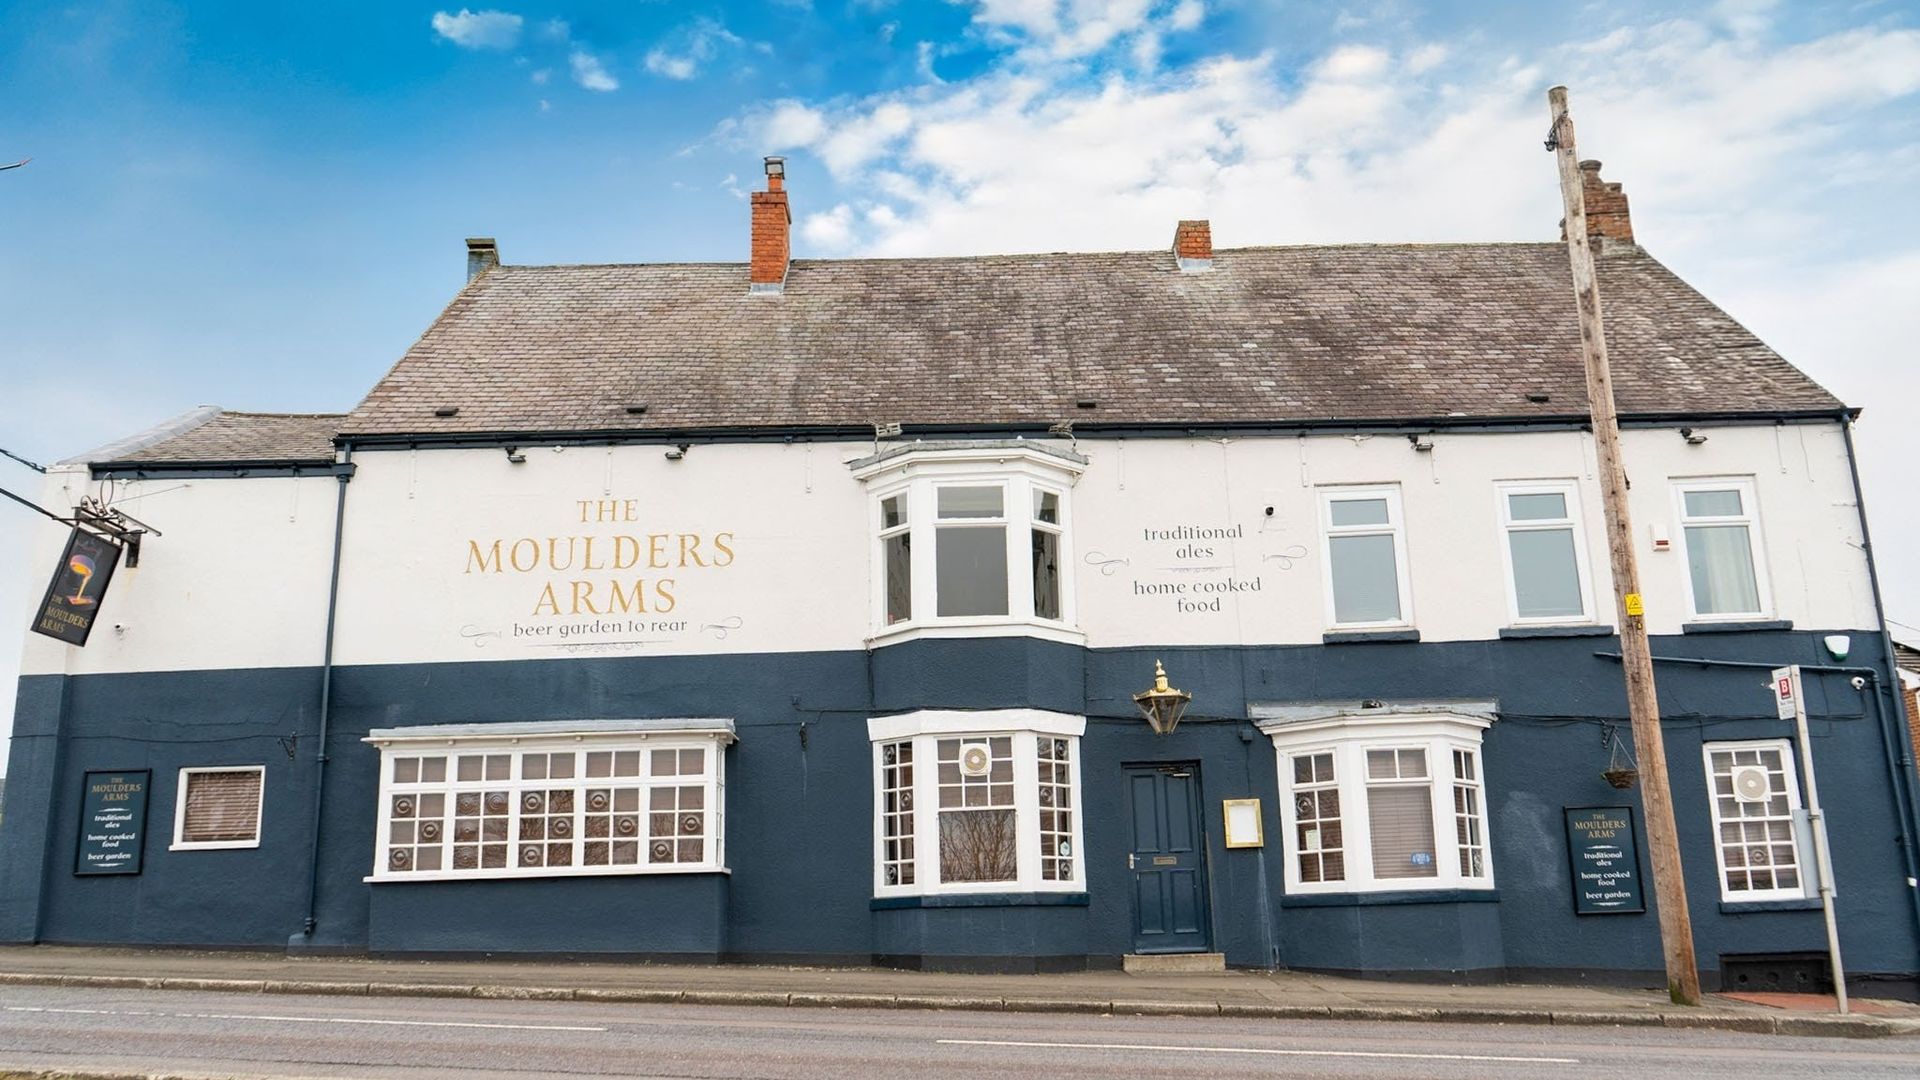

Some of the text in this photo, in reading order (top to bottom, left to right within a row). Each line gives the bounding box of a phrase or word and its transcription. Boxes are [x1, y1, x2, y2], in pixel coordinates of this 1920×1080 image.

[576, 498, 639, 522] THE
[1144, 524, 1244, 541] traditional
[463, 532, 736, 574] MOULDERS
[1175, 543, 1214, 559] ales
[1133, 576, 1262, 596] home cooked
[532, 579, 676, 616] ARMS
[1177, 596, 1221, 614] food
[47, 607, 89, 628] MOULDERS
[40, 618, 64, 633] ARMS
[513, 620, 688, 638] beer garden to rear
[1781, 680, 1788, 693] B
[92, 784, 142, 793] MOULDERS
[103, 793, 129, 801] ARMS
[1574, 820, 1626, 830] MOULDERS
[1588, 830, 1616, 838] ARMS
[105, 852, 132, 861] garden
[1597, 878, 1616, 886] food
[1604, 891, 1631, 900] garden
